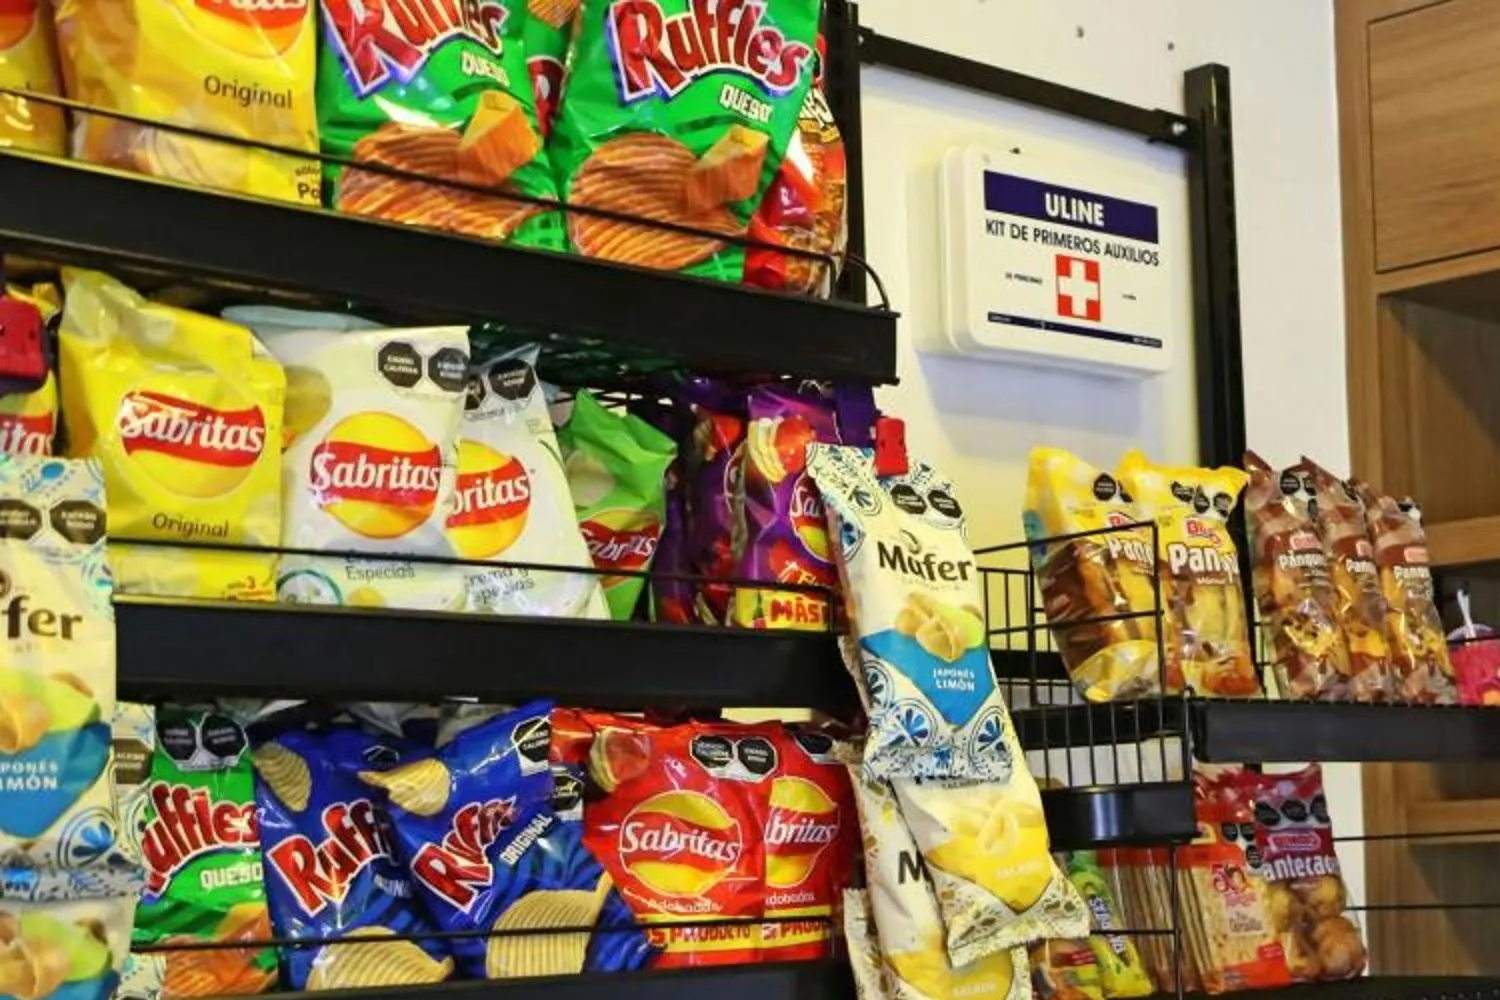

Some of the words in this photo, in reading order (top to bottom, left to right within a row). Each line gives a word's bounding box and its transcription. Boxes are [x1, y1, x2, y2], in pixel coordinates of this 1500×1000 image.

[203, 75, 293, 109] Original
[719, 83, 774, 123] QUESO
[1044, 192, 1105, 228] ULINE
[985, 218, 1004, 237] KIT
[1010, 223, 1028, 242] DE
[1033, 227, 1101, 255] PRIMEROS
[1103, 246, 1160, 267] AUXILIOS
[117, 394, 265, 453] Sabritas
[312, 452, 441, 491] Sabritas
[152, 511, 230, 540] Original
[935, 679, 976, 693] LIMÓN
[500, 812, 554, 866] ORIGINAL
[622, 821, 741, 863] Sabritas
